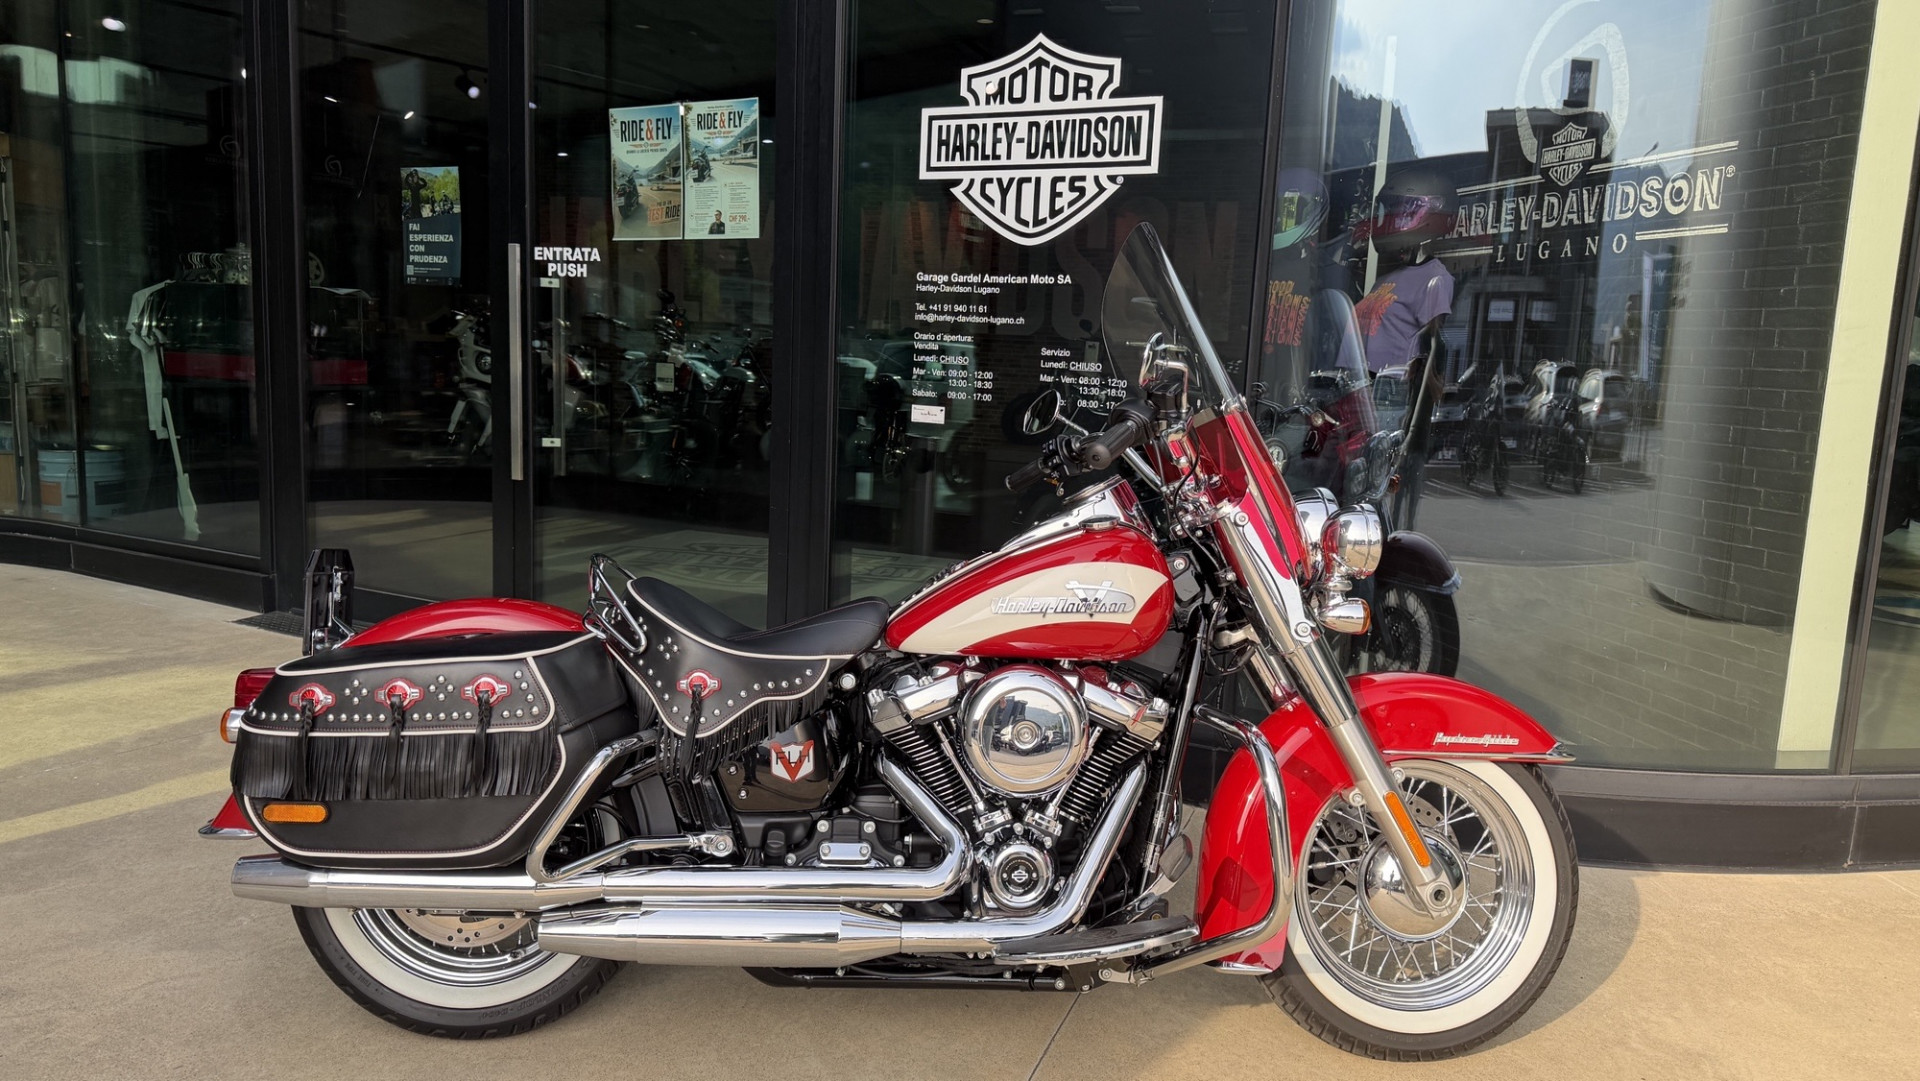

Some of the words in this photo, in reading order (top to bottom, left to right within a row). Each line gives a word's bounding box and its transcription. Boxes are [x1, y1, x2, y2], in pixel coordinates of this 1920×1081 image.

[985, 56, 1094, 106] MOTOR
[936, 115, 1143, 163] HARLEY-DAVIDSON
[980, 175, 1087, 229] CYCLES
[665, 205, 681, 219] RIDE
[409, 223, 420, 231] FAI
[409, 233, 454, 242] ESPERIENZA
[409, 244, 425, 252] CON
[1495, 233, 1628, 263] LUGANO
[409, 254, 448, 263] PRUDENZA
[534, 246, 601, 262] ENTRATA
[547, 262, 588, 278] PUSH
[916, 272, 949, 284] Garage
[950, 273, 981, 284] Gardel
[983, 273, 1028, 284] American
[1030, 274, 1055, 284] Moto
[1057, 274, 1072, 284] SA
[916, 284, 972, 293] Harley-Davidson
[973, 285, 1000, 295] Lugano
[915, 303, 927, 311] Tel.
[943, 304, 952, 312] 91
[953, 304, 967, 312] 940
[978, 305, 987, 313] 61
[914, 312, 1025, 325] info@harley-davidson-lugano.ch
[914, 332, 935, 341] Orario
[913, 342, 939, 350] Vendita
[1040, 347, 1071, 357] Servizio
[939, 355, 970, 365] CHIUSO
[1069, 361, 1103, 372] CHIUSO
[912, 367, 926, 375] Mar
[931, 368, 947, 376] Ven:
[947, 369, 968, 378] 09:00
[974, 371, 993, 380] 12:00
[948, 379, 967, 388] 13:00
[973, 381, 993, 389] 18:30
[1039, 374, 1054, 382] Mar
[1060, 375, 1077, 384] Ven:
[1078, 376, 1100, 386] 08:00
[912, 389, 938, 398] Sabato:
[947, 391, 967, 400] 09:00
[973, 393, 992, 401] 17:00
[1079, 386, 1100, 396] 13:30
[1077, 399, 1099, 409] 08:00
[993, 596, 1127, 618] Harley-Davidson
[775, 750, 810, 765] FLH
